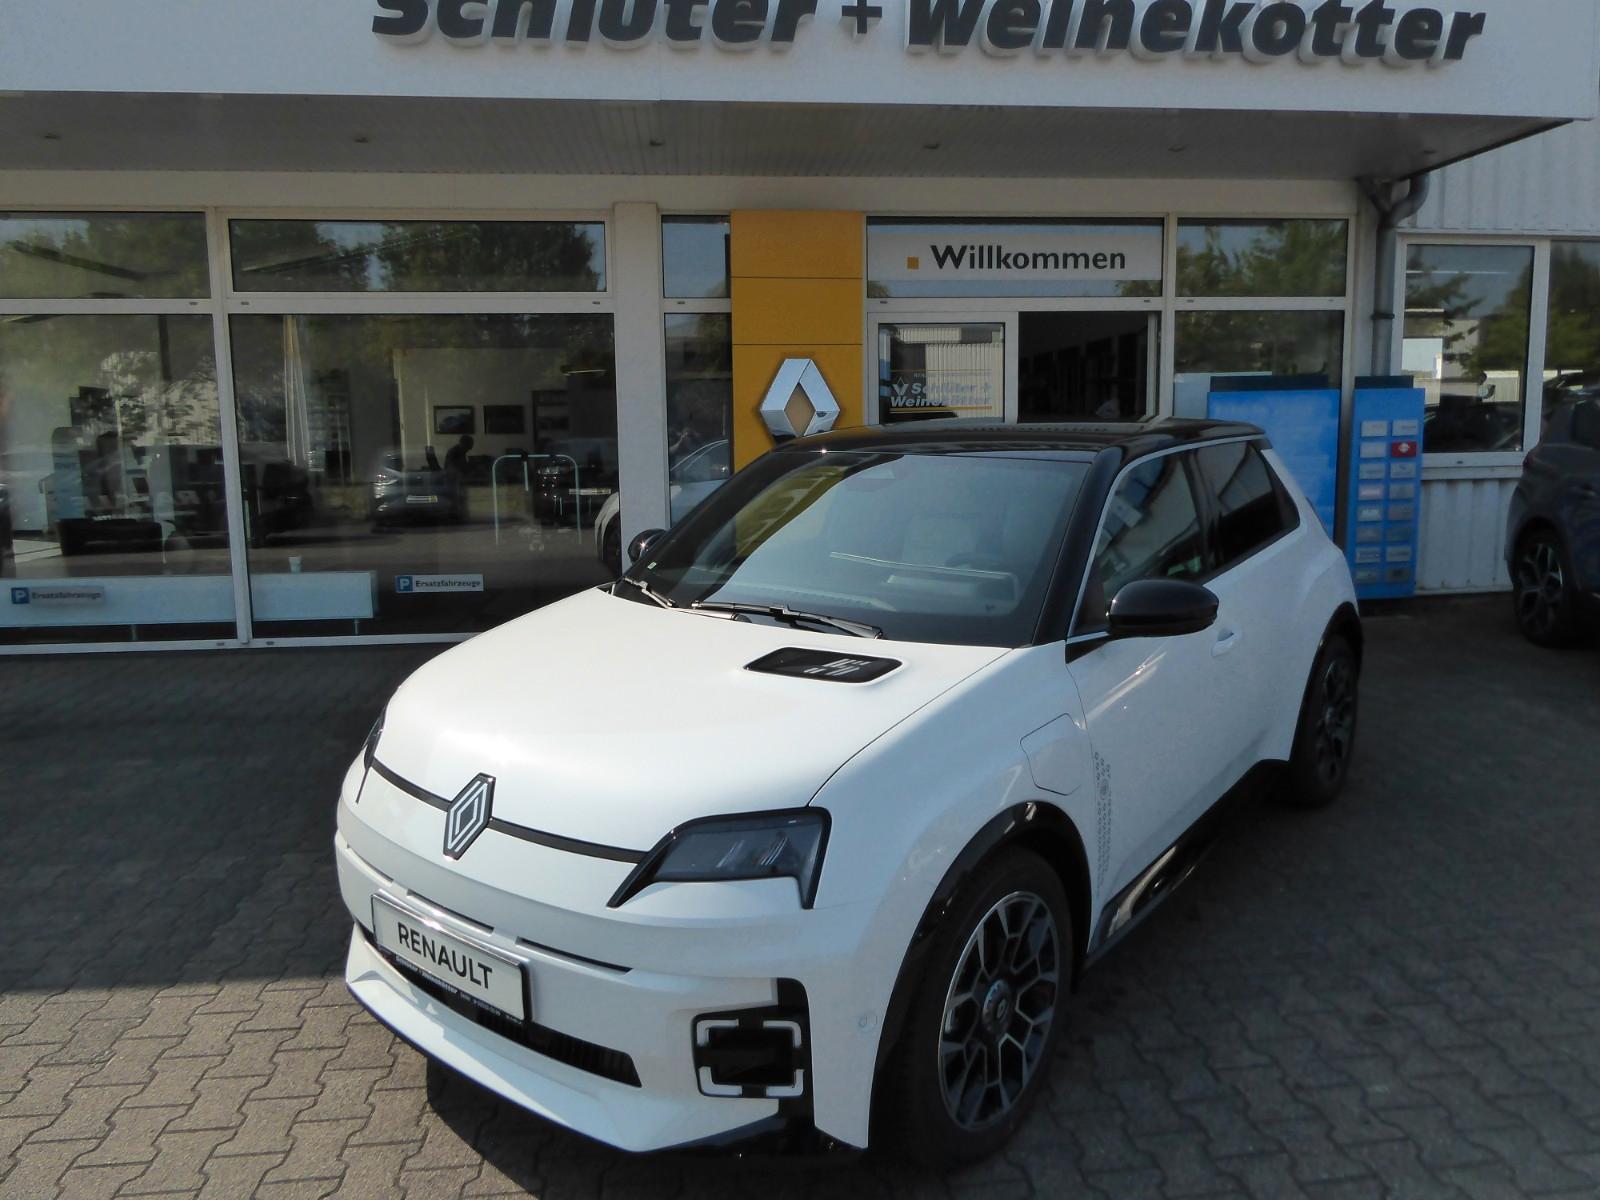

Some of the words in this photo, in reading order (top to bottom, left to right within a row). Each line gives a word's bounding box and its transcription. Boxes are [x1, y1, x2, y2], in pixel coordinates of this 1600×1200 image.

[841, 0, 883, 35] +
[930, 244, 1126, 270] Willkommen
[415, 579, 481, 588] Ersatzfahrzeuge
[397, 922, 493, 989] RENAULT
